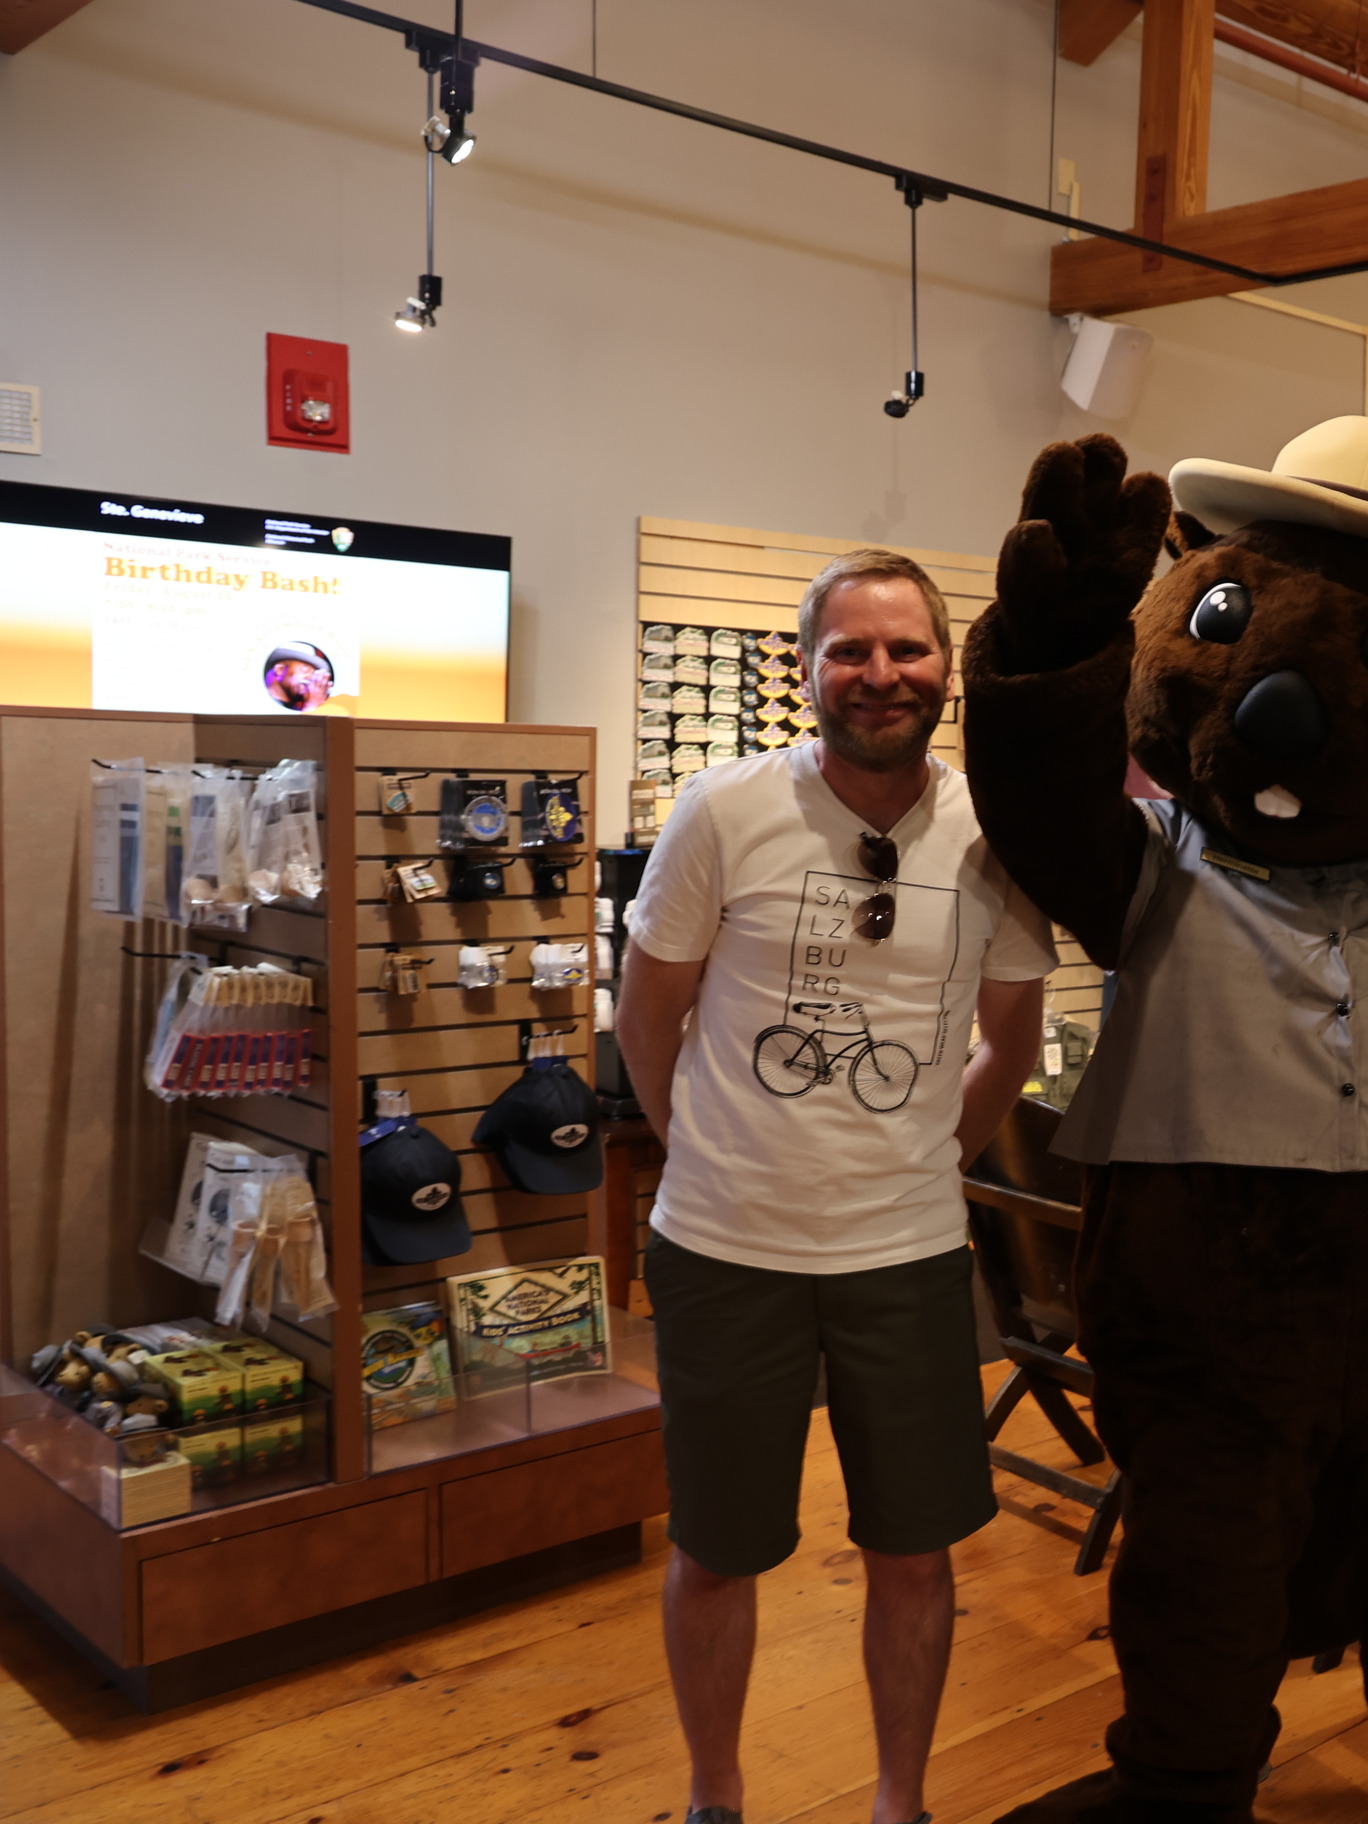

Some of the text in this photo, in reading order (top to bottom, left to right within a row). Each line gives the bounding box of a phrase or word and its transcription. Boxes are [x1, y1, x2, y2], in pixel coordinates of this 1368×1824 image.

[100, 501, 205, 524] Ste. Genevieve
[103, 542, 271, 566] National Park Service
[103, 556, 341, 595] Birthday Bash!
[815, 885, 850, 910] SA
[809, 914, 845, 939] LZ
[806, 945, 847, 968] BU
[801, 973, 841, 996] RG
